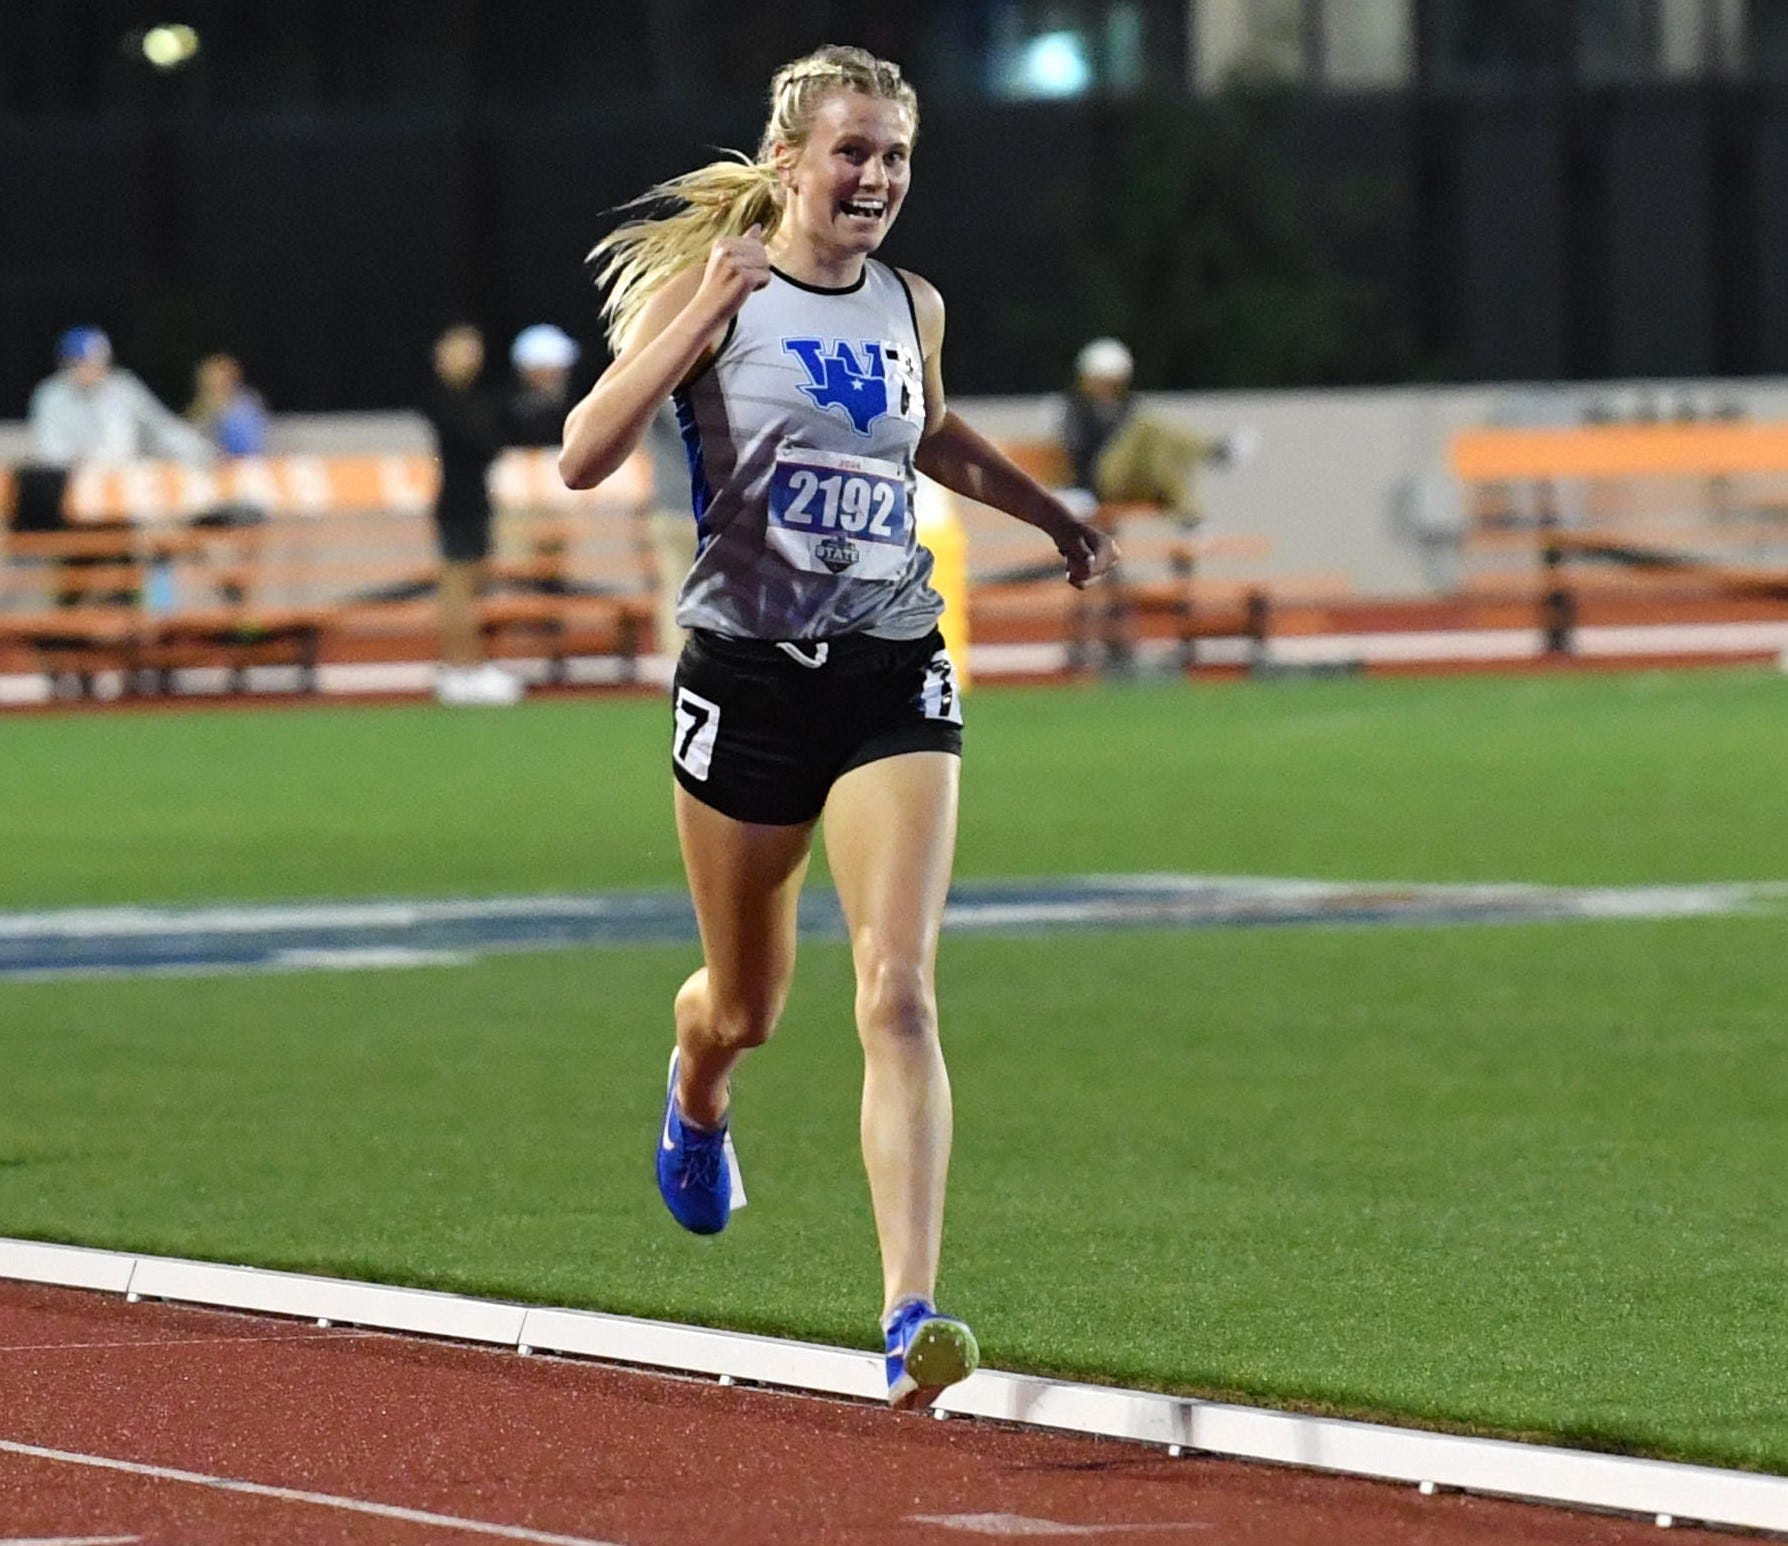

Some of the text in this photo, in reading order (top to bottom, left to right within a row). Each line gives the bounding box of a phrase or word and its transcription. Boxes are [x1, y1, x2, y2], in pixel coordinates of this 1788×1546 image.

[784, 470, 895, 536] 2192
[816, 545, 859, 563] STATE
[680, 698, 710, 761] 7
